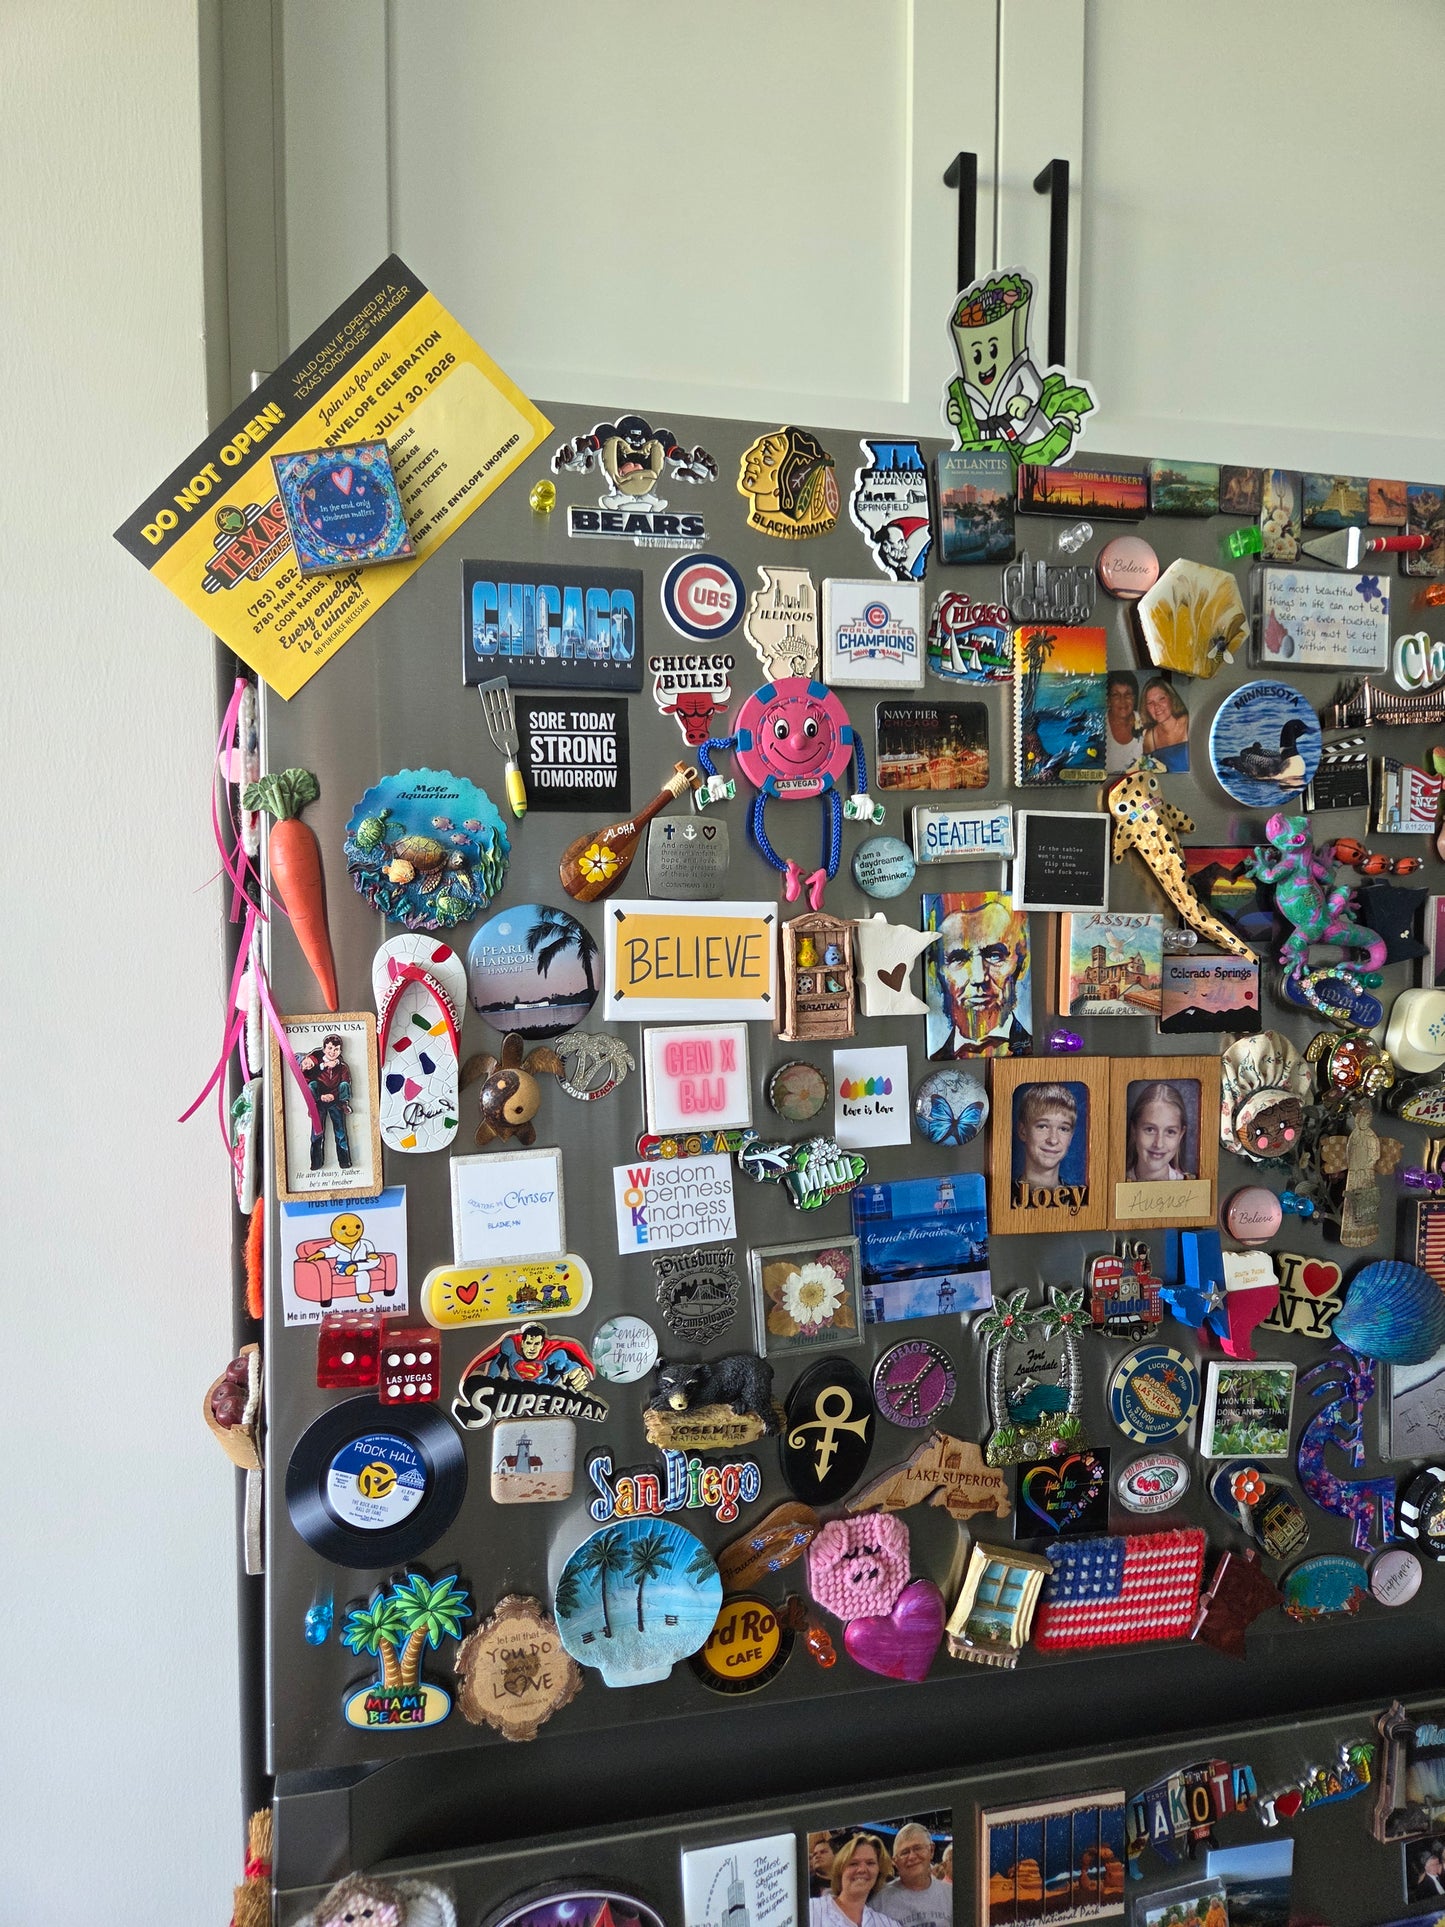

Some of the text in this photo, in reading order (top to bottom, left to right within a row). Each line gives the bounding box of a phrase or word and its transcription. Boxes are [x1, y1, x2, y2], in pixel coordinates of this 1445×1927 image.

[292, 285, 396, 385] VALID ONLY IF OPENED BY A
[405, 385, 427, 403] 30,
[425, 353, 456, 384] 2026
[319, 352, 391, 427] Join us for our
[325, 331, 442, 447] ENVELOPE CELEBRATION
[945, 457, 1008, 470] ATLANTIS
[141, 402, 285, 545] DO NOT OPEN!
[406, 461, 448, 505] FAIR TICKETS
[871, 471, 924, 486] ILLINOIS
[1073, 471, 1143, 485] SONORAN DESERT
[858, 503, 909, 512] SPRINGFIELD
[574, 510, 704, 537] BEARS
[752, 513, 836, 536] BLACKHAWKS
[250, 535, 291, 579] ROADHOUSE
[1113, 559, 1150, 575] Believe
[1267, 581, 1353, 597] The most beautiful
[274, 581, 328, 632] COON RAPIDS,
[279, 569, 364, 649] Every envelope
[940, 592, 1010, 633] CHICAGO
[1012, 595, 1090, 624] Chicago
[1268, 599, 1380, 613] things in life can not be
[298, 584, 364, 653] is a winner!
[472, 580, 636, 661] CHICAGO
[760, 610, 813, 622] ILLINOIS
[314, 598, 371, 656] NO PURCHASE NECESSARY
[1295, 627, 1377, 640] they must be felt
[840, 634, 914, 652] CHAMPIONS
[1298, 642, 1376, 655] within the heart
[509, 658, 546, 666] KIND
[593, 661, 632, 669] TOWN
[650, 654, 736, 672] CHICAGO
[664, 672, 723, 690] BULLS
[1233, 686, 1299, 709] MINNESOTA
[529, 711, 615, 730] SORE TODAY
[884, 710, 938, 719] NAVY PIER
[530, 736, 617, 763] STRONG
[531, 770, 617, 788] TOMORROW
[776, 779, 817, 788] LAS VEGAS
[603, 823, 635, 842] ALOHA
[927, 820, 1001, 847] SEATTLE
[1405, 823, 1432, 831] 9.11.2001
[860, 855, 904, 868] daydreamer
[861, 868, 875, 877] and
[1085, 914, 1151, 929] ASSISI
[483, 945, 525, 955] PEARL
[624, 934, 763, 985] BELIEVE
[475, 954, 535, 968] HARBOR
[1170, 967, 1252, 980] Colorado Springs
[423, 973, 461, 1032] BARCELONA
[665, 1039, 736, 1076] GEN X
[562, 1082, 590, 1100] SOUTH
[679, 1078, 726, 1114] BJJ
[1415, 1103, 1439, 1116] LAS
[627, 1165, 715, 1188] Wisdom
[798, 1162, 854, 1194] MAUI
[504, 1189, 554, 1209] Chris67
[624, 1179, 732, 1208] Openness
[822, 1182, 856, 1197] HAWAII
[1012, 1181, 1089, 1216] Joey
[1128, 1190, 1199, 1214] August
[632, 1199, 727, 1226] Kindness
[1238, 1211, 1274, 1225] Believe
[653, 1250, 736, 1278] Pittsburgh
[1280, 1259, 1302, 1293] I
[1103, 1298, 1150, 1316] London
[1264, 1296, 1339, 1333] NY
[614, 1325, 654, 1342] enjoy
[890, 1343, 927, 1363] PEACE
[1026, 1348, 1046, 1362] Fort
[386, 1374, 432, 1384] LAS VEGAS
[1013, 1362, 1059, 1377] Lauderdale
[1148, 1362, 1188, 1391] LUCKY CHIP
[466, 1386, 609, 1428] SUPERMAN
[1136, 1383, 1176, 1414] LAS VEGAS
[1134, 1406, 1155, 1424] $1000
[671, 1425, 748, 1435] YOSEMITE
[354, 1442, 385, 1458] ROCK
[389, 1450, 417, 1466] HALL
[588, 1449, 762, 1523] San Diego
[906, 1469, 1001, 1488] LAKE SUPERIOR
[1139, 1491, 1174, 1505] COMPANY
[486, 1642, 551, 1663] YOU DO
[726, 1647, 763, 1667] CAFE
[366, 1695, 425, 1710] MIAMI
[369, 1710, 424, 1724] BEACH
[1133, 1765, 1250, 1840] DAKOTA
[1039, 1906, 1101, 1924] National Park
